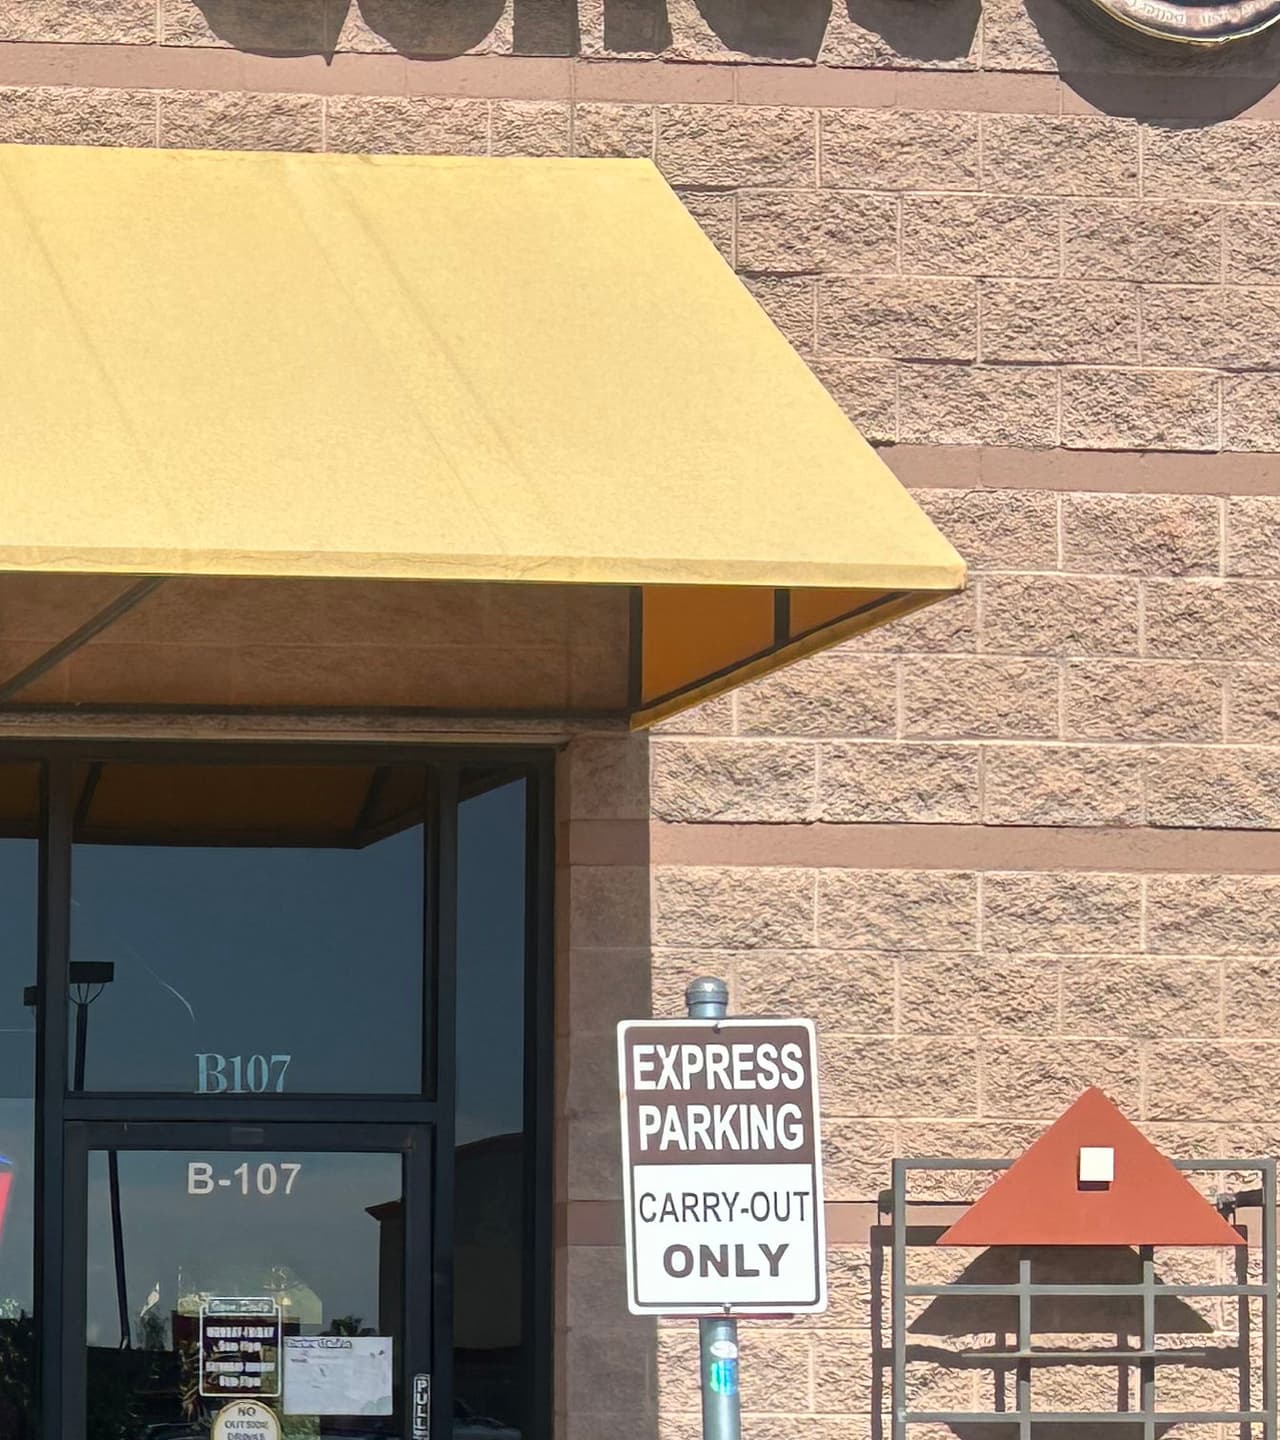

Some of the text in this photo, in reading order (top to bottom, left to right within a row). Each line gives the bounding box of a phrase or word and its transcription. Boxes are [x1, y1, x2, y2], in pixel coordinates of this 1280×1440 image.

[194, 1054, 292, 1094] B107
[632, 1043, 805, 1091] EXPRESS
[639, 1103, 805, 1151] PARKING
[187, 1162, 302, 1195] B-107
[639, 1191, 810, 1224] CARRY-OUT
[662, 1243, 790, 1278] ONLY
[237, 1406, 256, 1417] NO
[415, 1380, 428, 1429] PULL
